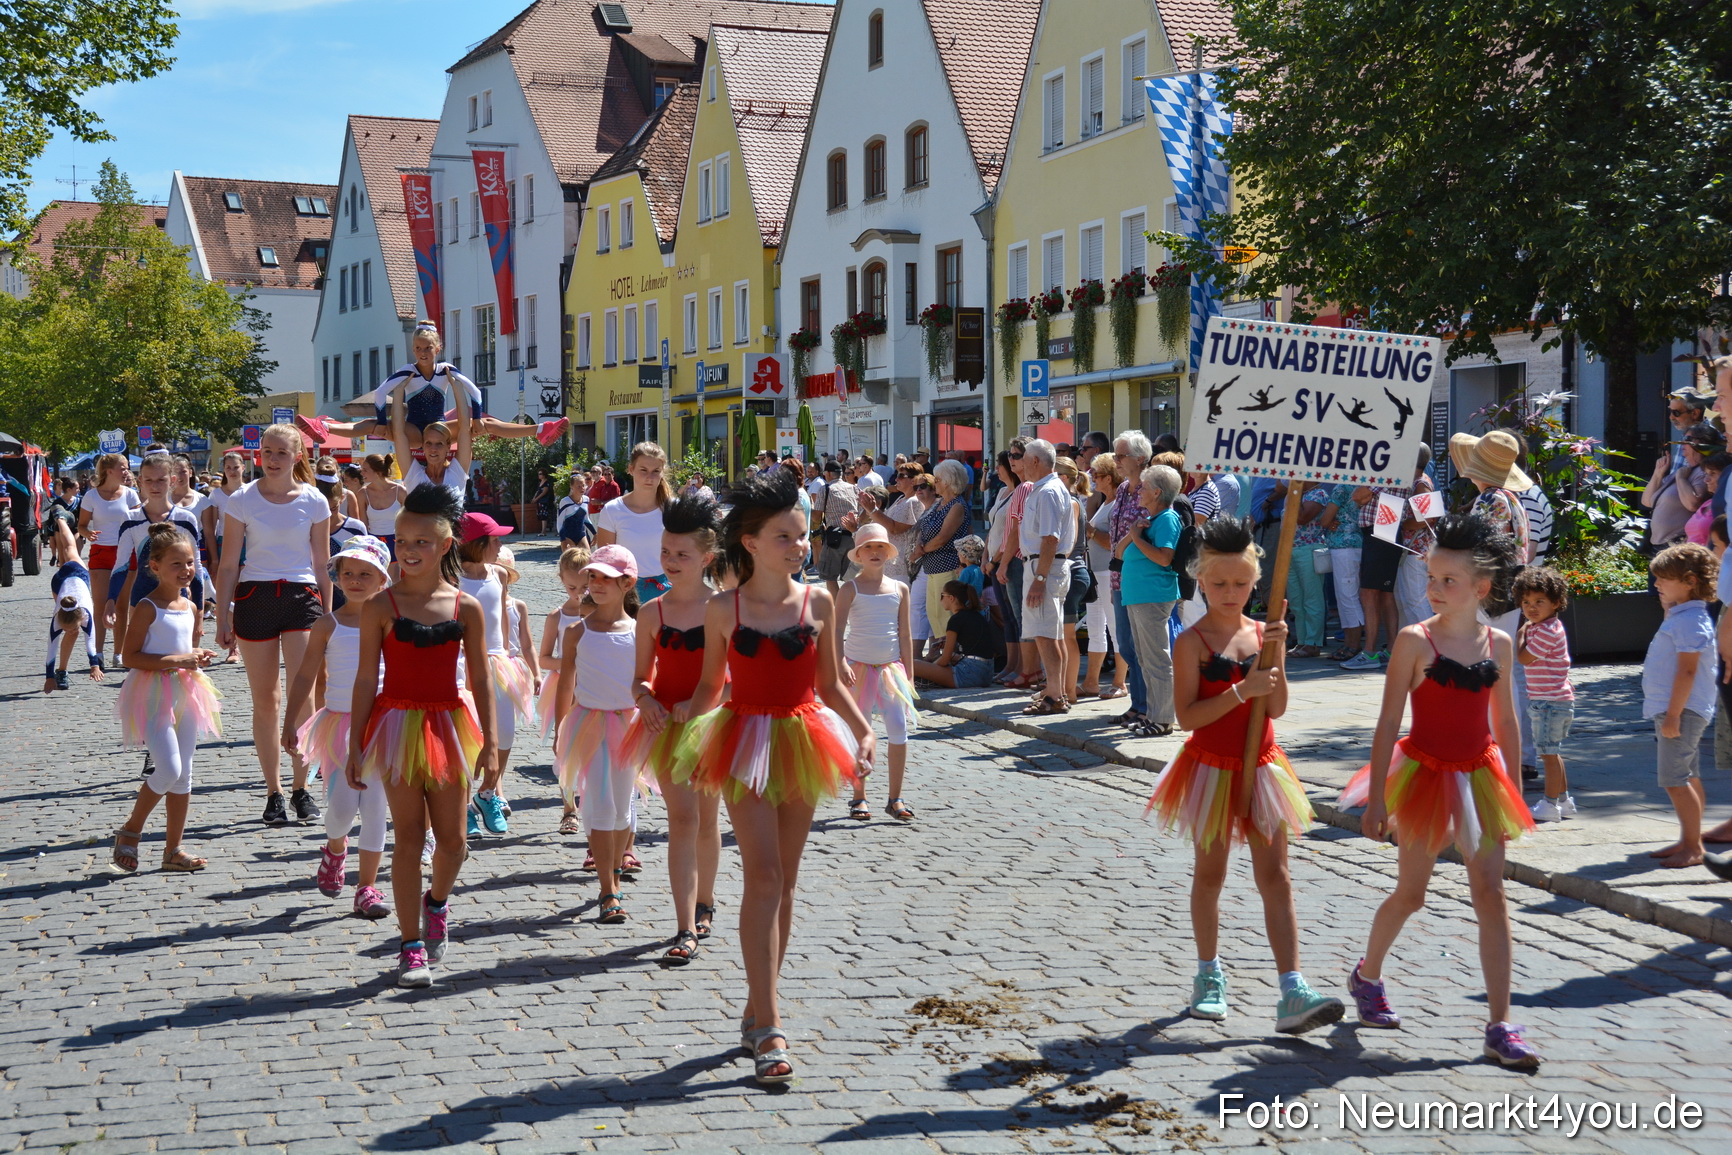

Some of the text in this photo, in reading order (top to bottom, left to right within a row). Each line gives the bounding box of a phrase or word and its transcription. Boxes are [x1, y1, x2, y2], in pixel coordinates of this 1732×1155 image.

[480, 157, 498, 196] K&L
[610, 272, 668, 300] HOTEL Lehmeier
[1048, 343, 1064, 355] WOLLE
[1209, 332, 1433, 384] TURNABTEILUNG
[698, 366, 702, 389] P
[704, 367, 722, 382] AIFUN
[1028, 364, 1043, 393] P
[609, 390, 643, 406] Restaurant
[1291, 388, 1336, 423] SV
[1213, 420, 1391, 472] HÖHENBERG
